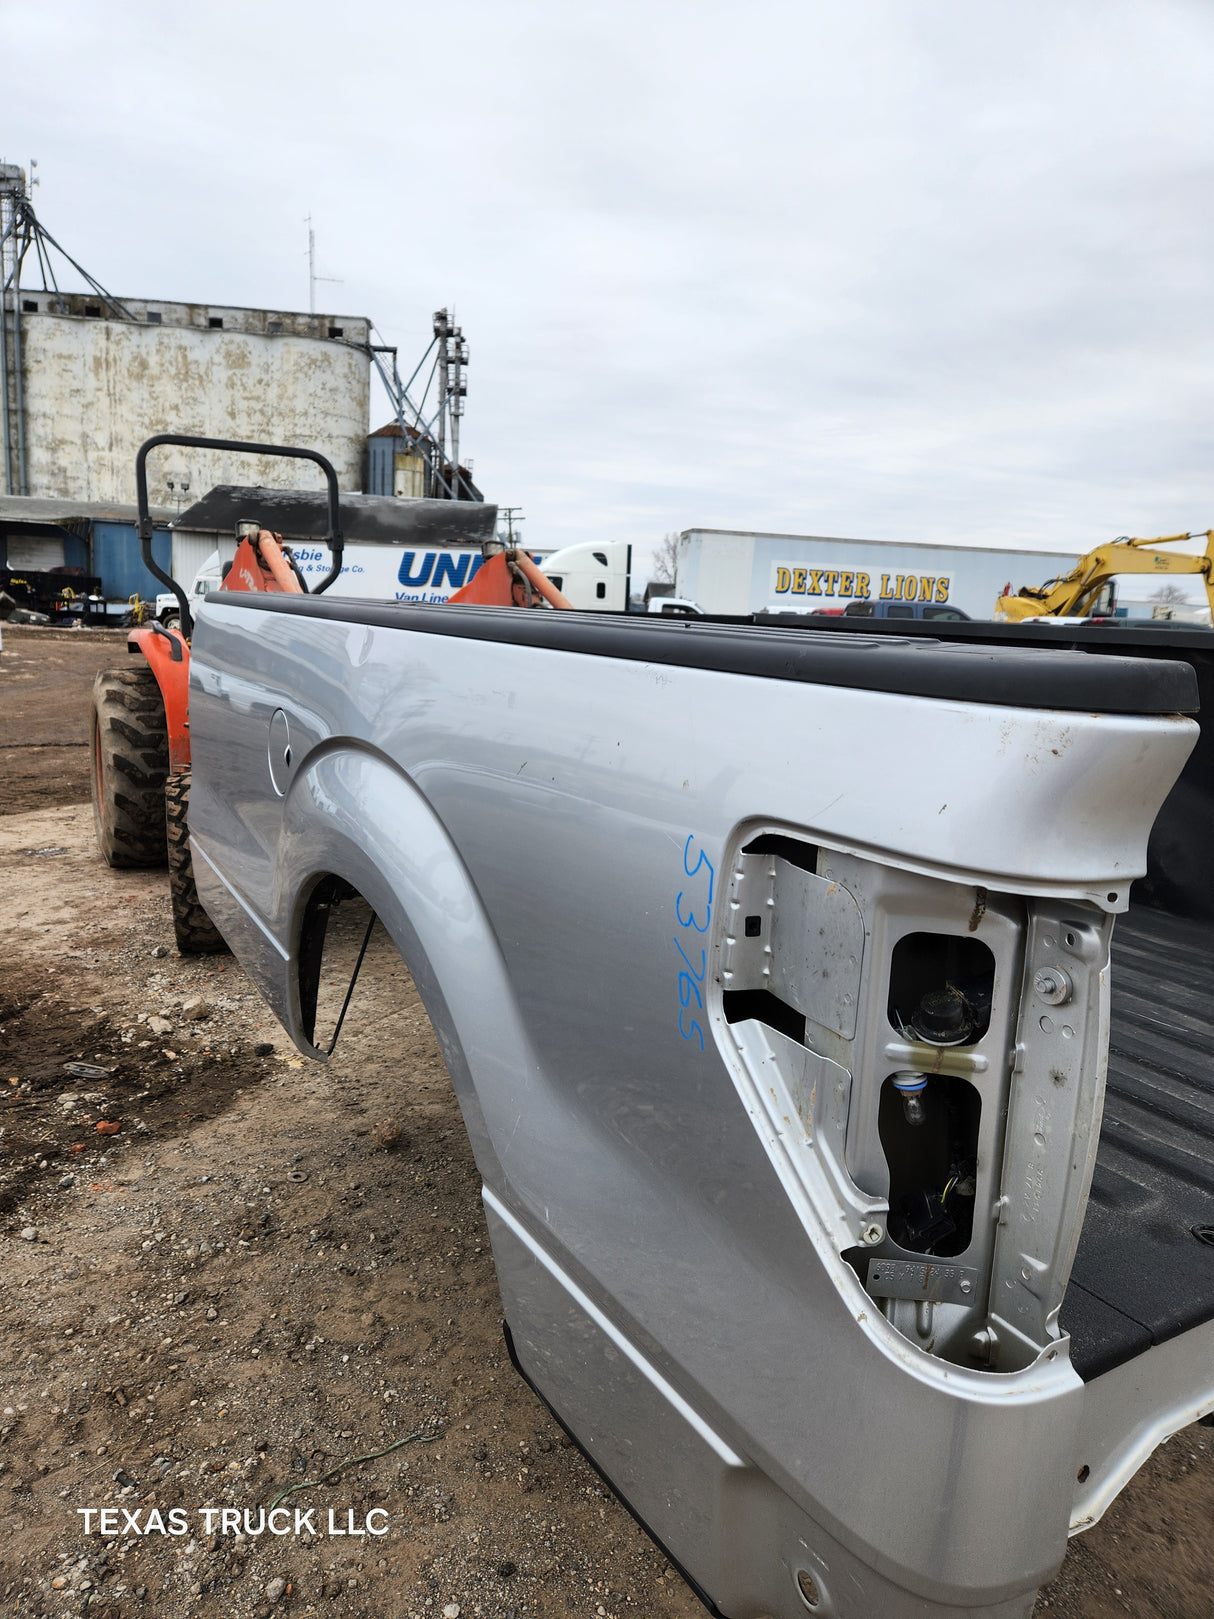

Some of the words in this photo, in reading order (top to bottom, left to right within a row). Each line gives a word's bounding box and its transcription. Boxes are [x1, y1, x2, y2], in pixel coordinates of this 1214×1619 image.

[315, 564, 350, 574] Stoge
[775, 567, 871, 599] DEXTER
[879, 574, 950, 604] LIONS
